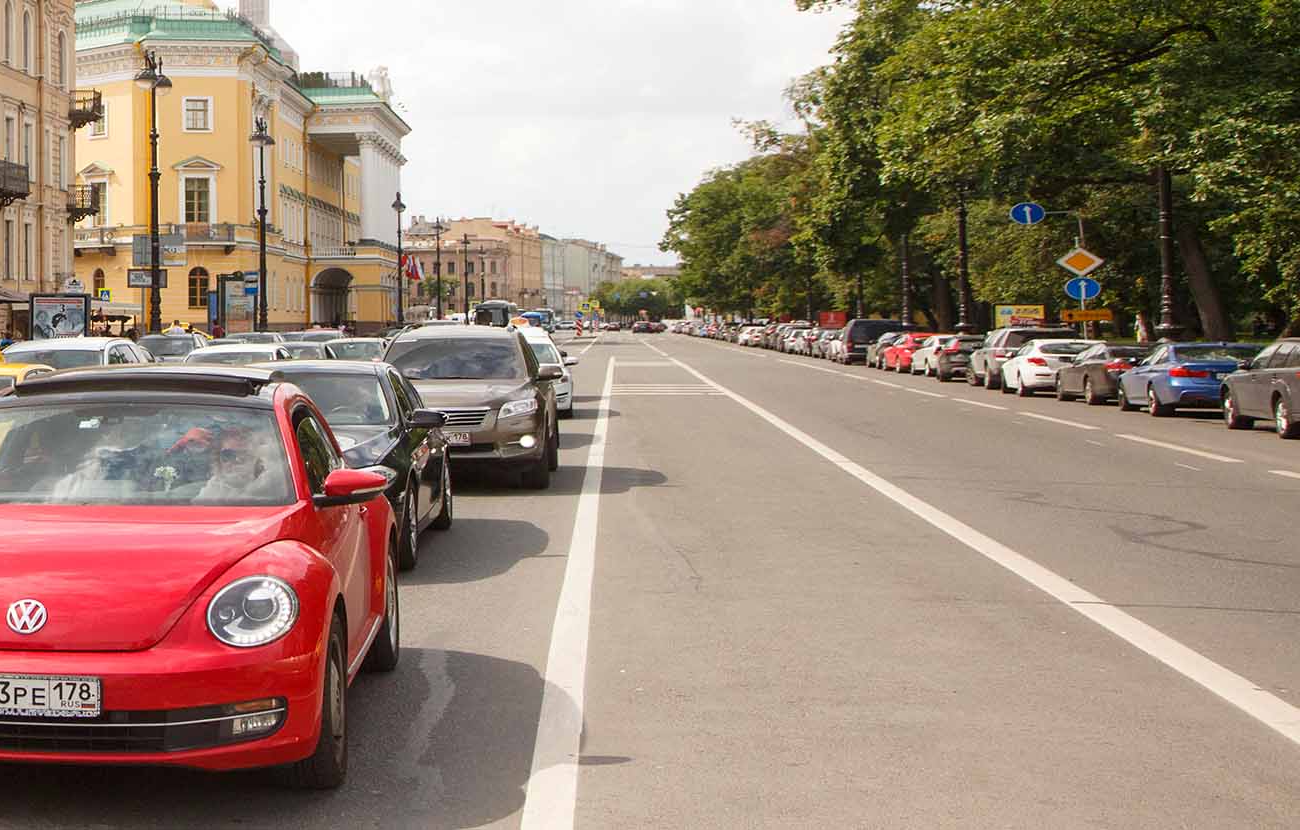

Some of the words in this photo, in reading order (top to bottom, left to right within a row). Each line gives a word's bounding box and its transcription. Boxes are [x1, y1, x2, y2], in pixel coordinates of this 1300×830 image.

[6, 599, 47, 634] VW
[52, 682, 92, 701] 178
[60, 700, 81, 708] RUS
